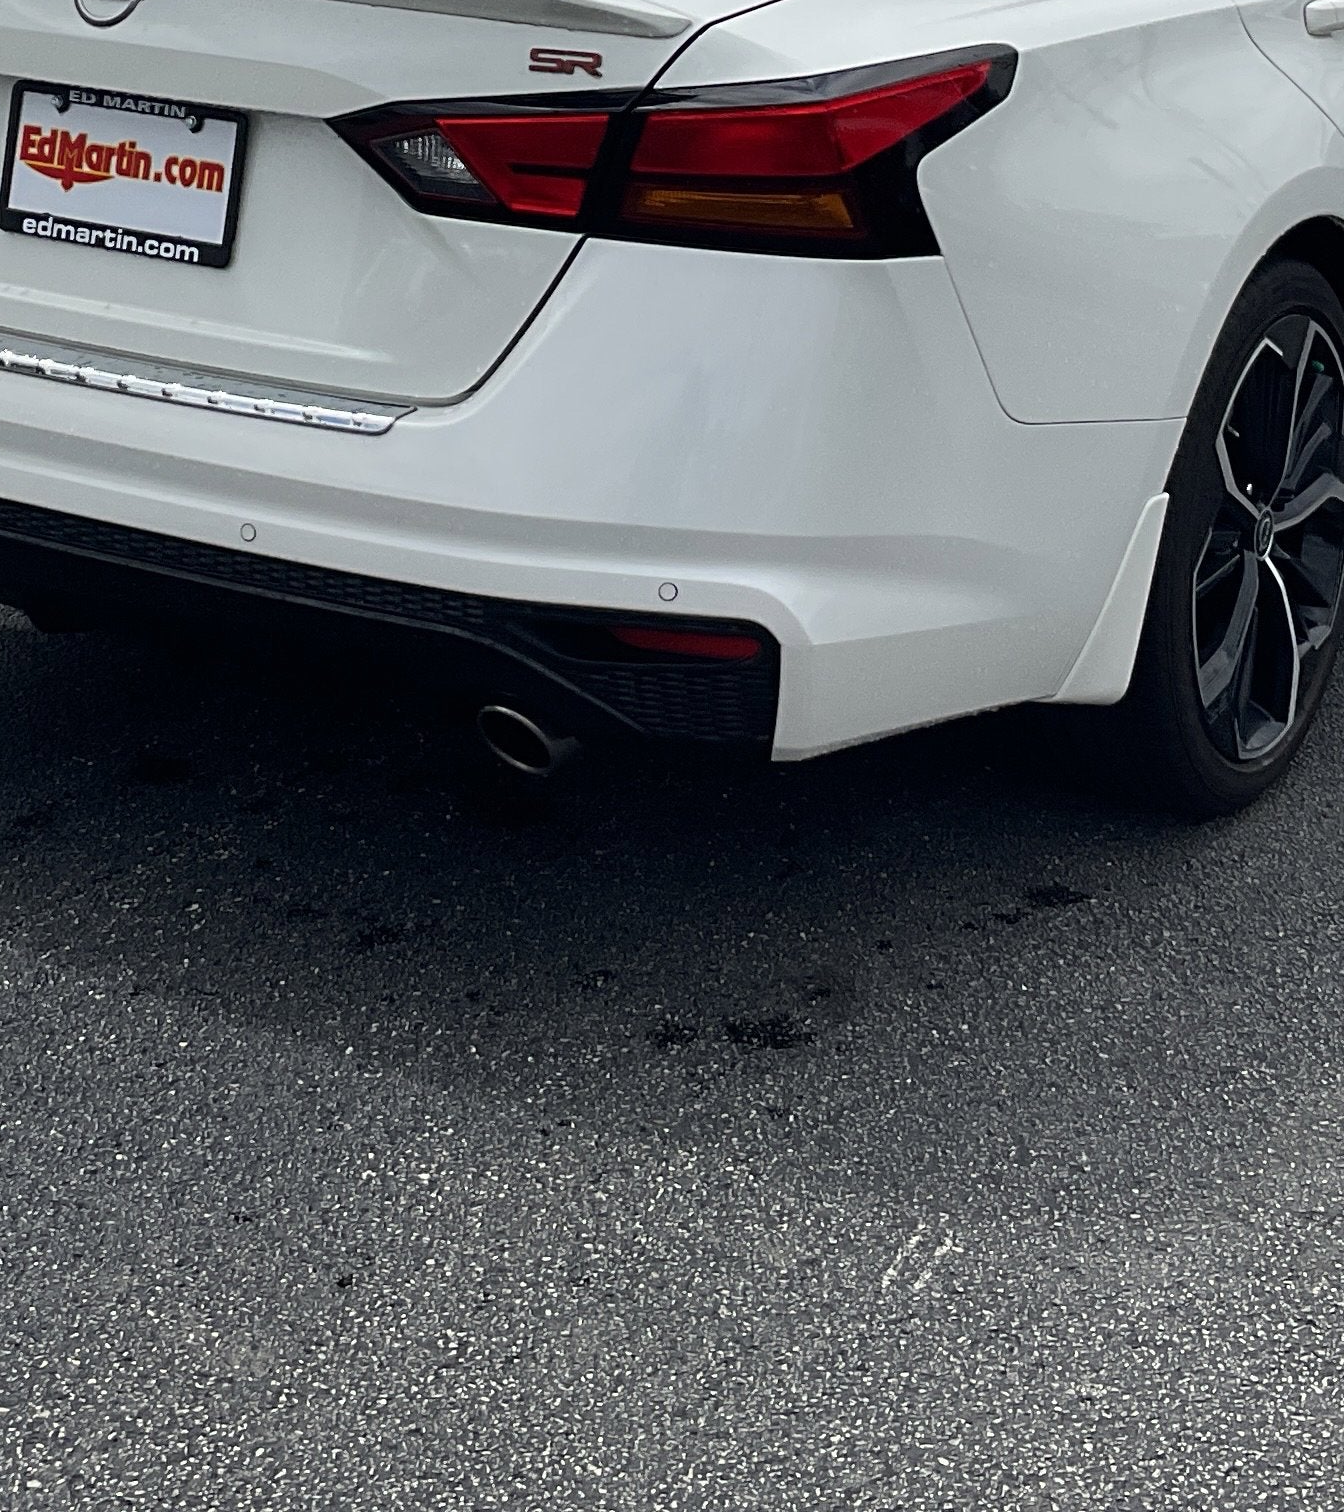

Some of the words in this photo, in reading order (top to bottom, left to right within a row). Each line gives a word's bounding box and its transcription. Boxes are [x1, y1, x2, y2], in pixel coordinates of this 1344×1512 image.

[528, 48, 603, 79] SR
[69, 90, 96, 104] ED
[103, 95, 186, 118] MARTIN
[20, 124, 225, 194] EdMartin.com
[22, 216, 200, 263] edmartin.com
